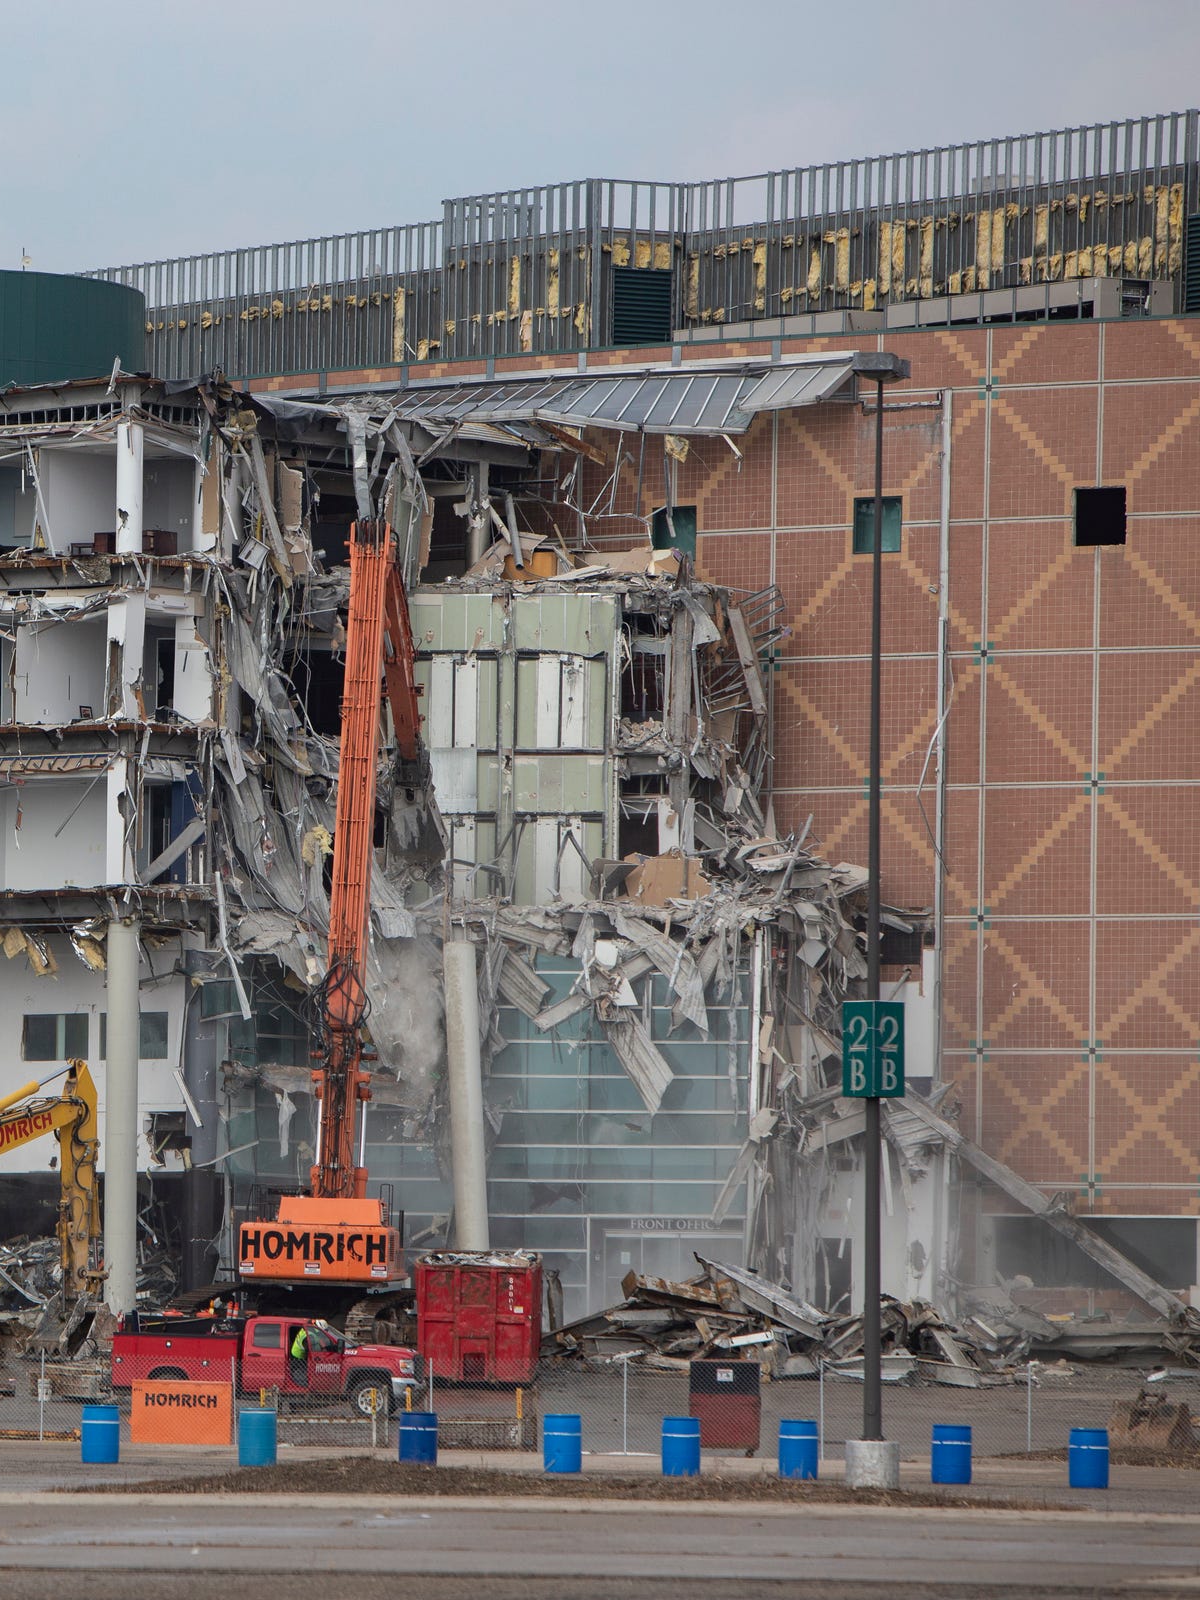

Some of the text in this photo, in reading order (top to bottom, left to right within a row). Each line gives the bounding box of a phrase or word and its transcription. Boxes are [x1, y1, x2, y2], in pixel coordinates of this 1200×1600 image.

[848, 1015, 868, 1053] 2
[879, 1015, 899, 1053] 2
[848, 1058, 867, 1092] B
[880, 1058, 898, 1091] B
[630, 1219, 721, 1230] FRONT OFFIC
[241, 1230, 386, 1266] HOMRICH
[315, 1363, 341, 1373] HOMRICH
[145, 1392, 218, 1409] HOMRICH
